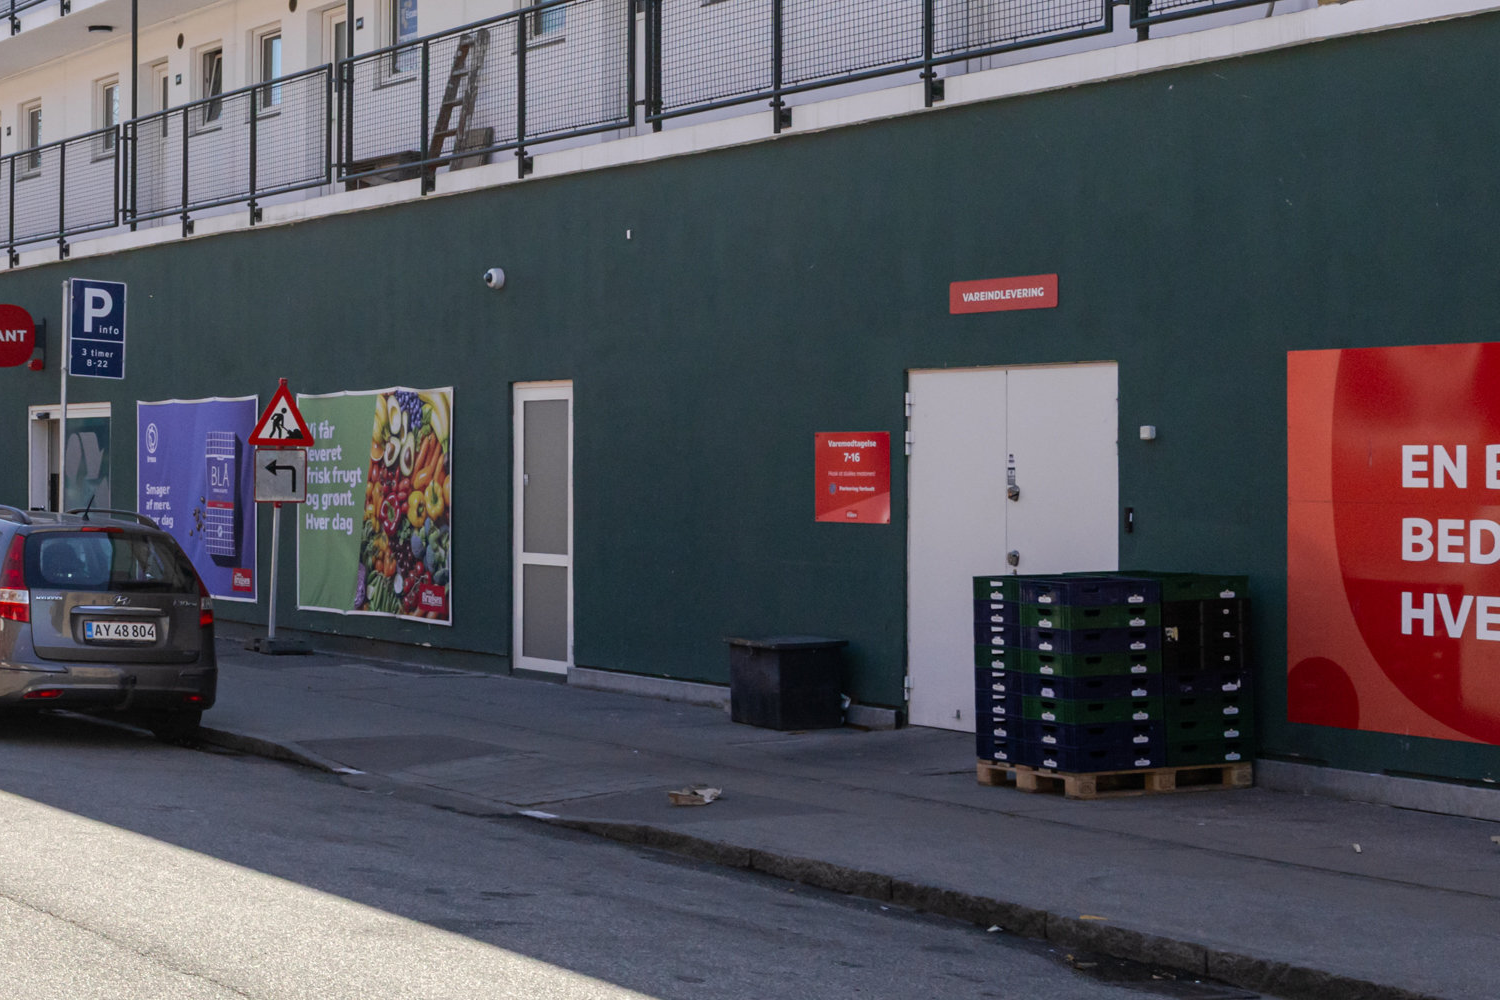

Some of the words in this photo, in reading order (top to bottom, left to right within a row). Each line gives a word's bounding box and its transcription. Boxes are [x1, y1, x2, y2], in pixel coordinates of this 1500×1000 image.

[962, 287, 1044, 302] VAREINDLEVERING
[84, 287, 113, 333] P
[99, 325, 120, 335] info
[81, 348, 87, 356] 3
[91, 349, 114, 358] timer
[86, 359, 108, 368] 8-22
[318, 418, 335, 440] får
[828, 440, 877, 449] Varemodtagelse
[843, 452, 861, 463] 7-16
[1402, 444, 1468, 489] EN
[211, 462, 230, 488] BLÅ
[306, 466, 331, 485] frisk
[332, 466, 363, 490] frugt
[145, 483, 171, 498] Smager
[145, 499, 154, 511] af
[306, 493, 320, 511] og
[321, 492, 355, 511] grønt.
[161, 515, 174, 529] dag
[306, 513, 330, 531] Hver
[332, 514, 354, 536] dag
[1402, 517, 1500, 565] BED
[1401, 591, 1500, 642] HVE
[94, 624, 111, 637] AY
[114, 624, 129, 638] 48
[132, 624, 155, 638] 804
